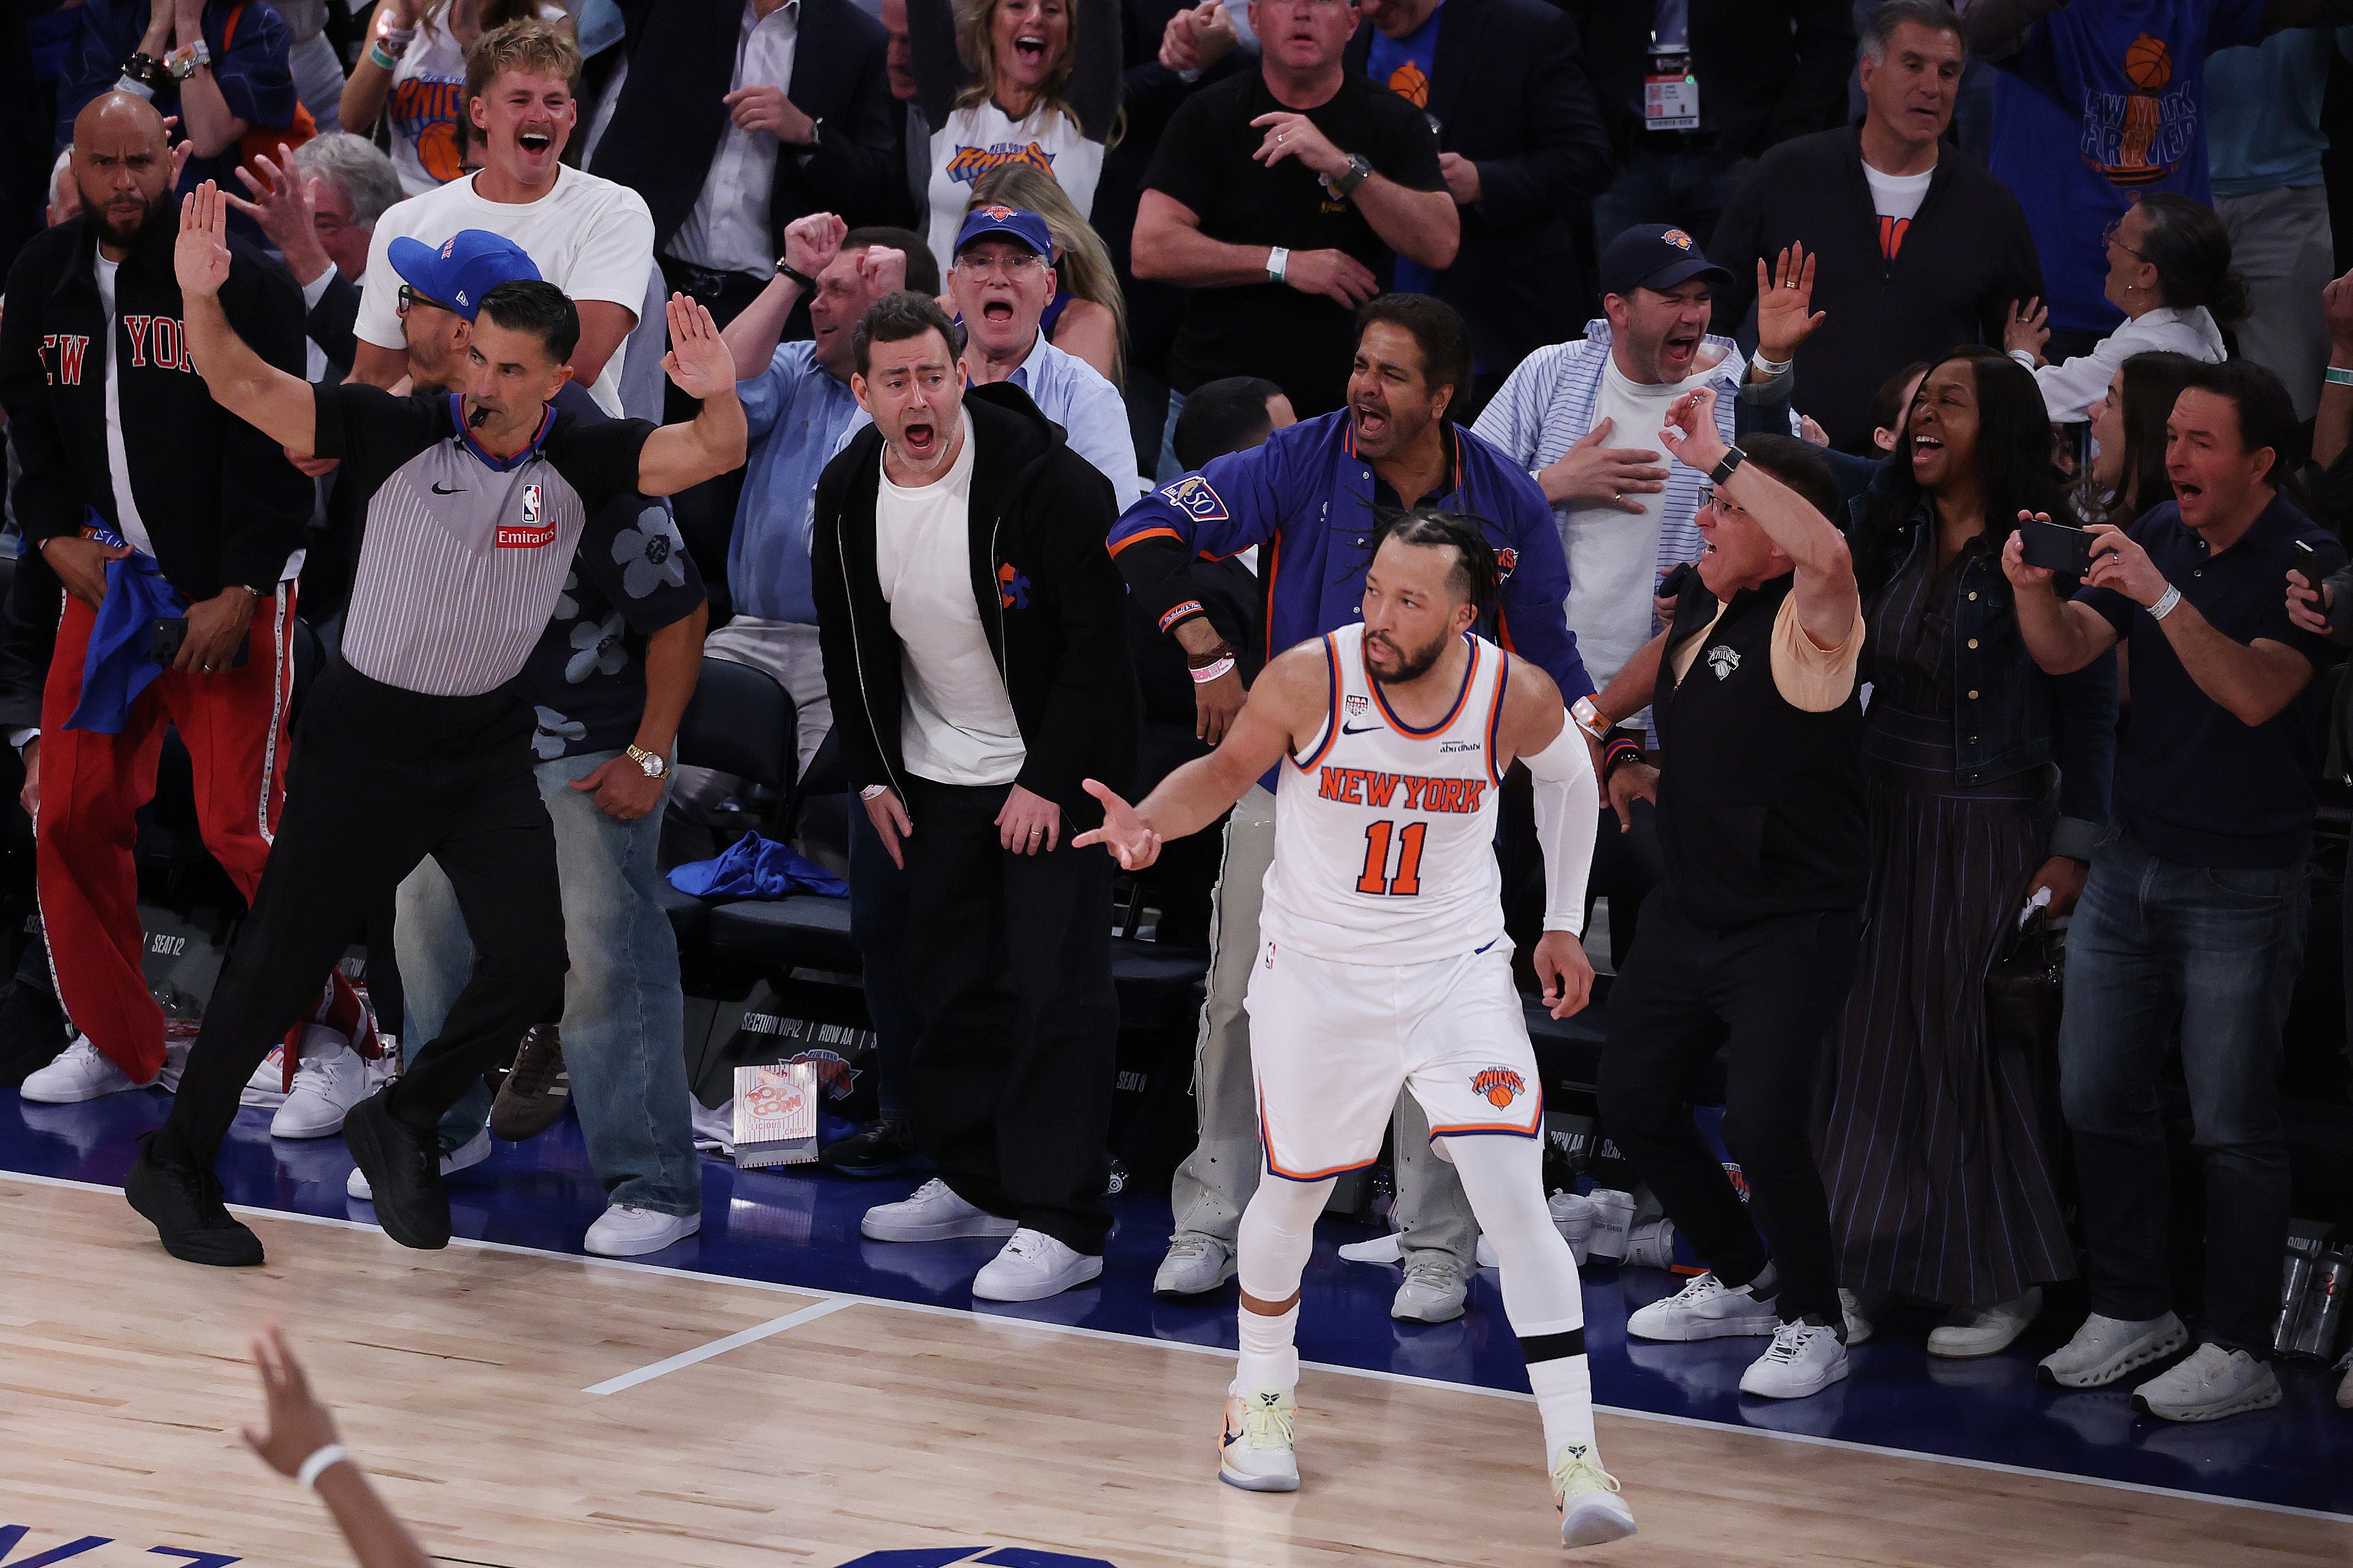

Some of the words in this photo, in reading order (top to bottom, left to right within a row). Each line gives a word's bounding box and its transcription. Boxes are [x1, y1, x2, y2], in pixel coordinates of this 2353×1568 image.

[1184, 491, 1215, 514] 50
[498, 529, 555, 543] Emirates
[1708, 649, 1738, 666] KNICKS
[1319, 766, 1400, 808] NEW
[1404, 775, 1487, 813] YORK
[1355, 820, 1428, 896] 11
[151, 933, 176, 955] SEAT
[172, 936, 186, 956] 12
[741, 1012, 779, 1035] SECTION
[778, 1017, 804, 1039] VIP12
[818, 1023, 842, 1044] ROW
[841, 1026, 855, 1046] AA
[1116, 1070, 1141, 1091] SEAT
[1138, 1074, 1148, 1092] 8
[1472, 1070, 1525, 1092] KNICKS
[748, 1087, 788, 1105] POP
[753, 1095, 802, 1116] CORN
[784, 1126, 807, 1136] CRISP
